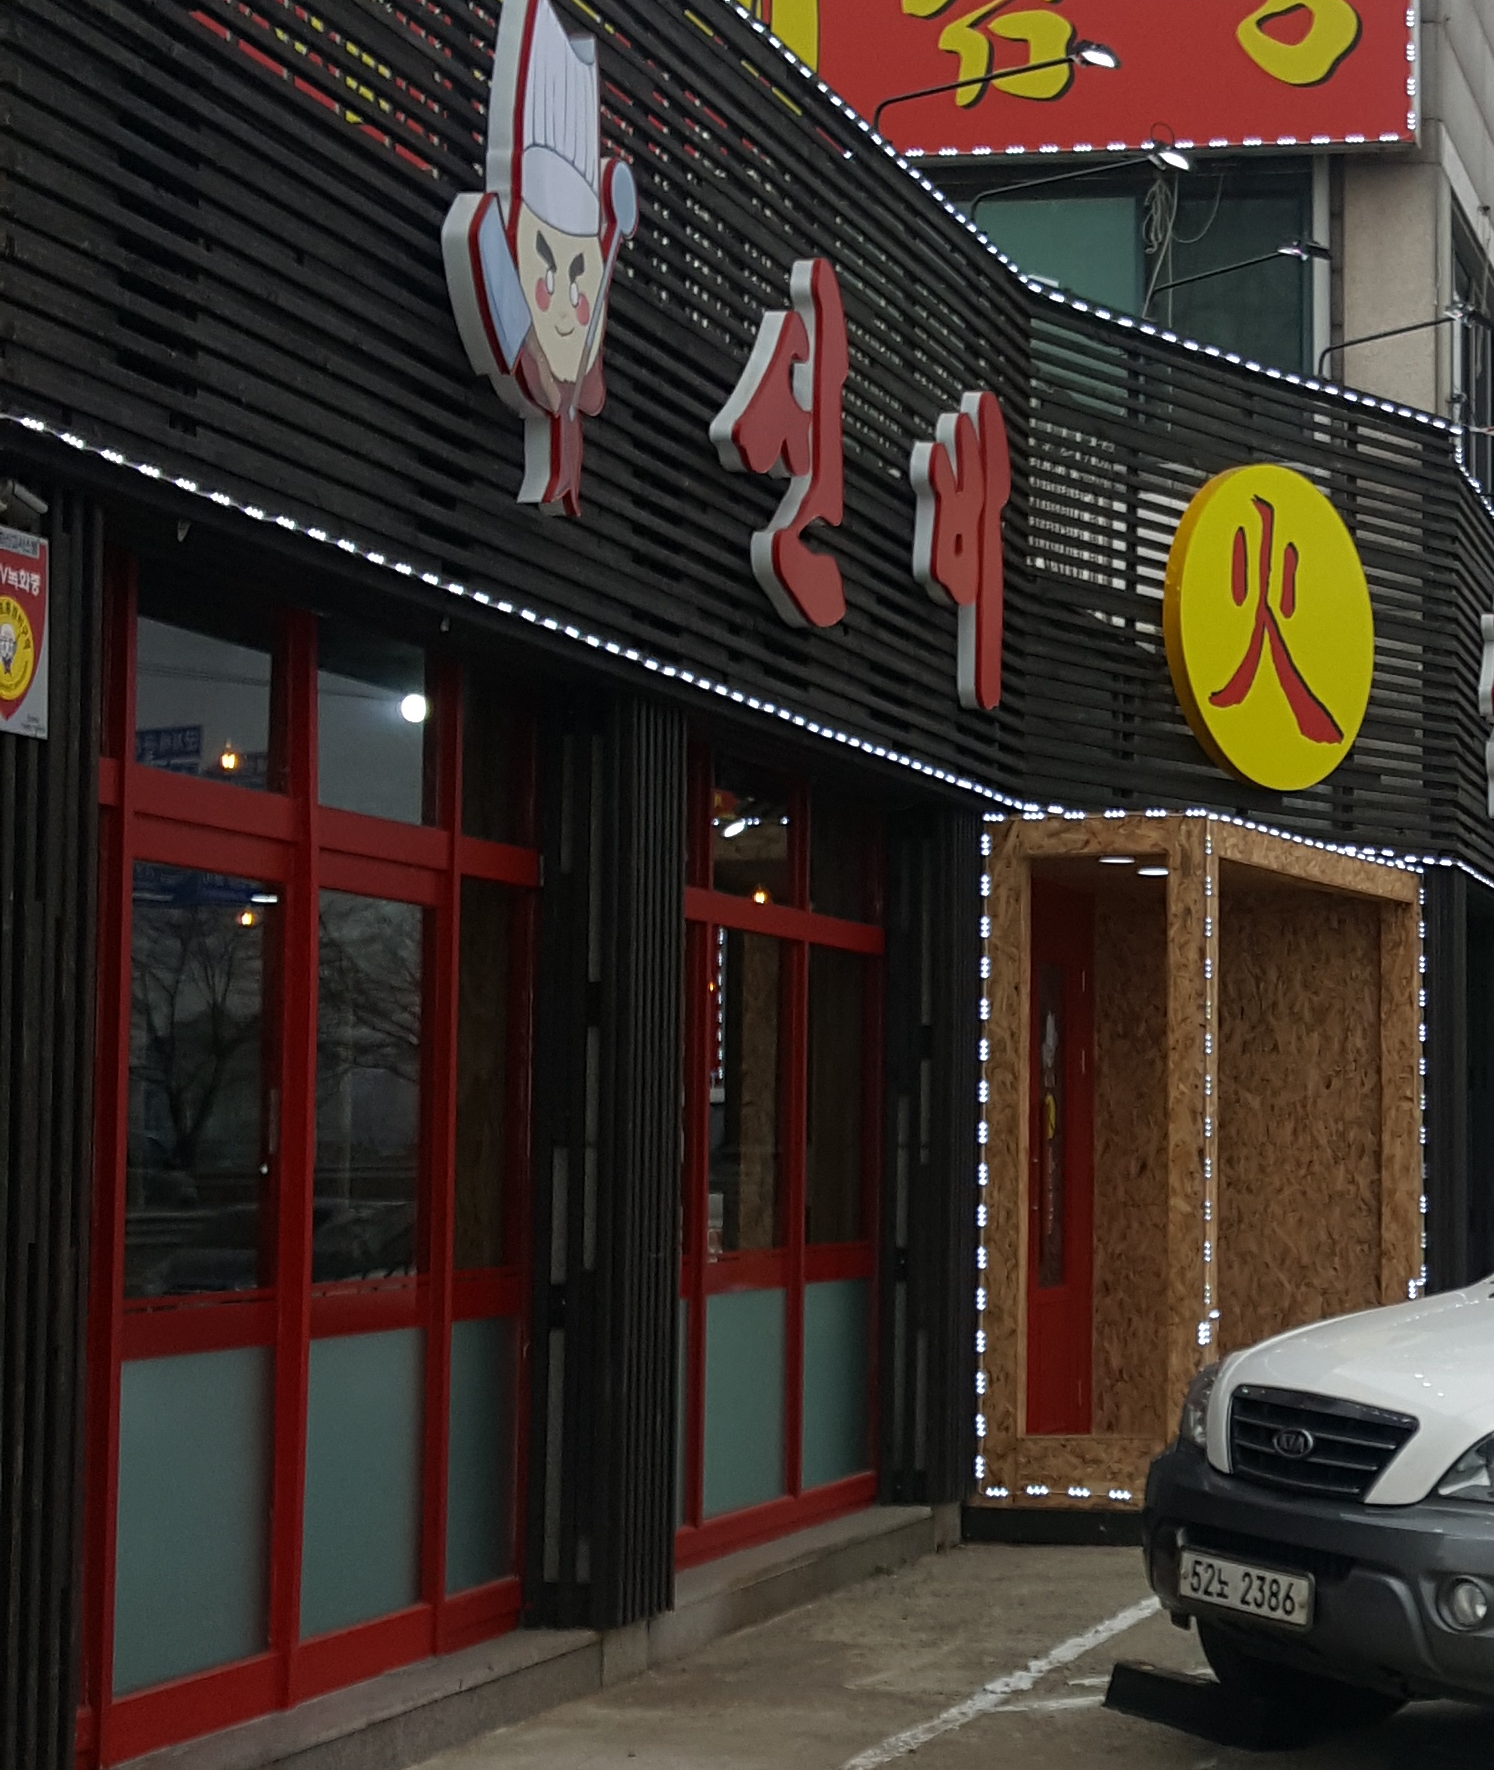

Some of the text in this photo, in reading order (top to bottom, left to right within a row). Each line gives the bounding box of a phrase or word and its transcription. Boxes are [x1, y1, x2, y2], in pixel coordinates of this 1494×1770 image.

[1208, 494, 1344, 745] 火
[1190, 1559, 1296, 1616] 52노 2386
